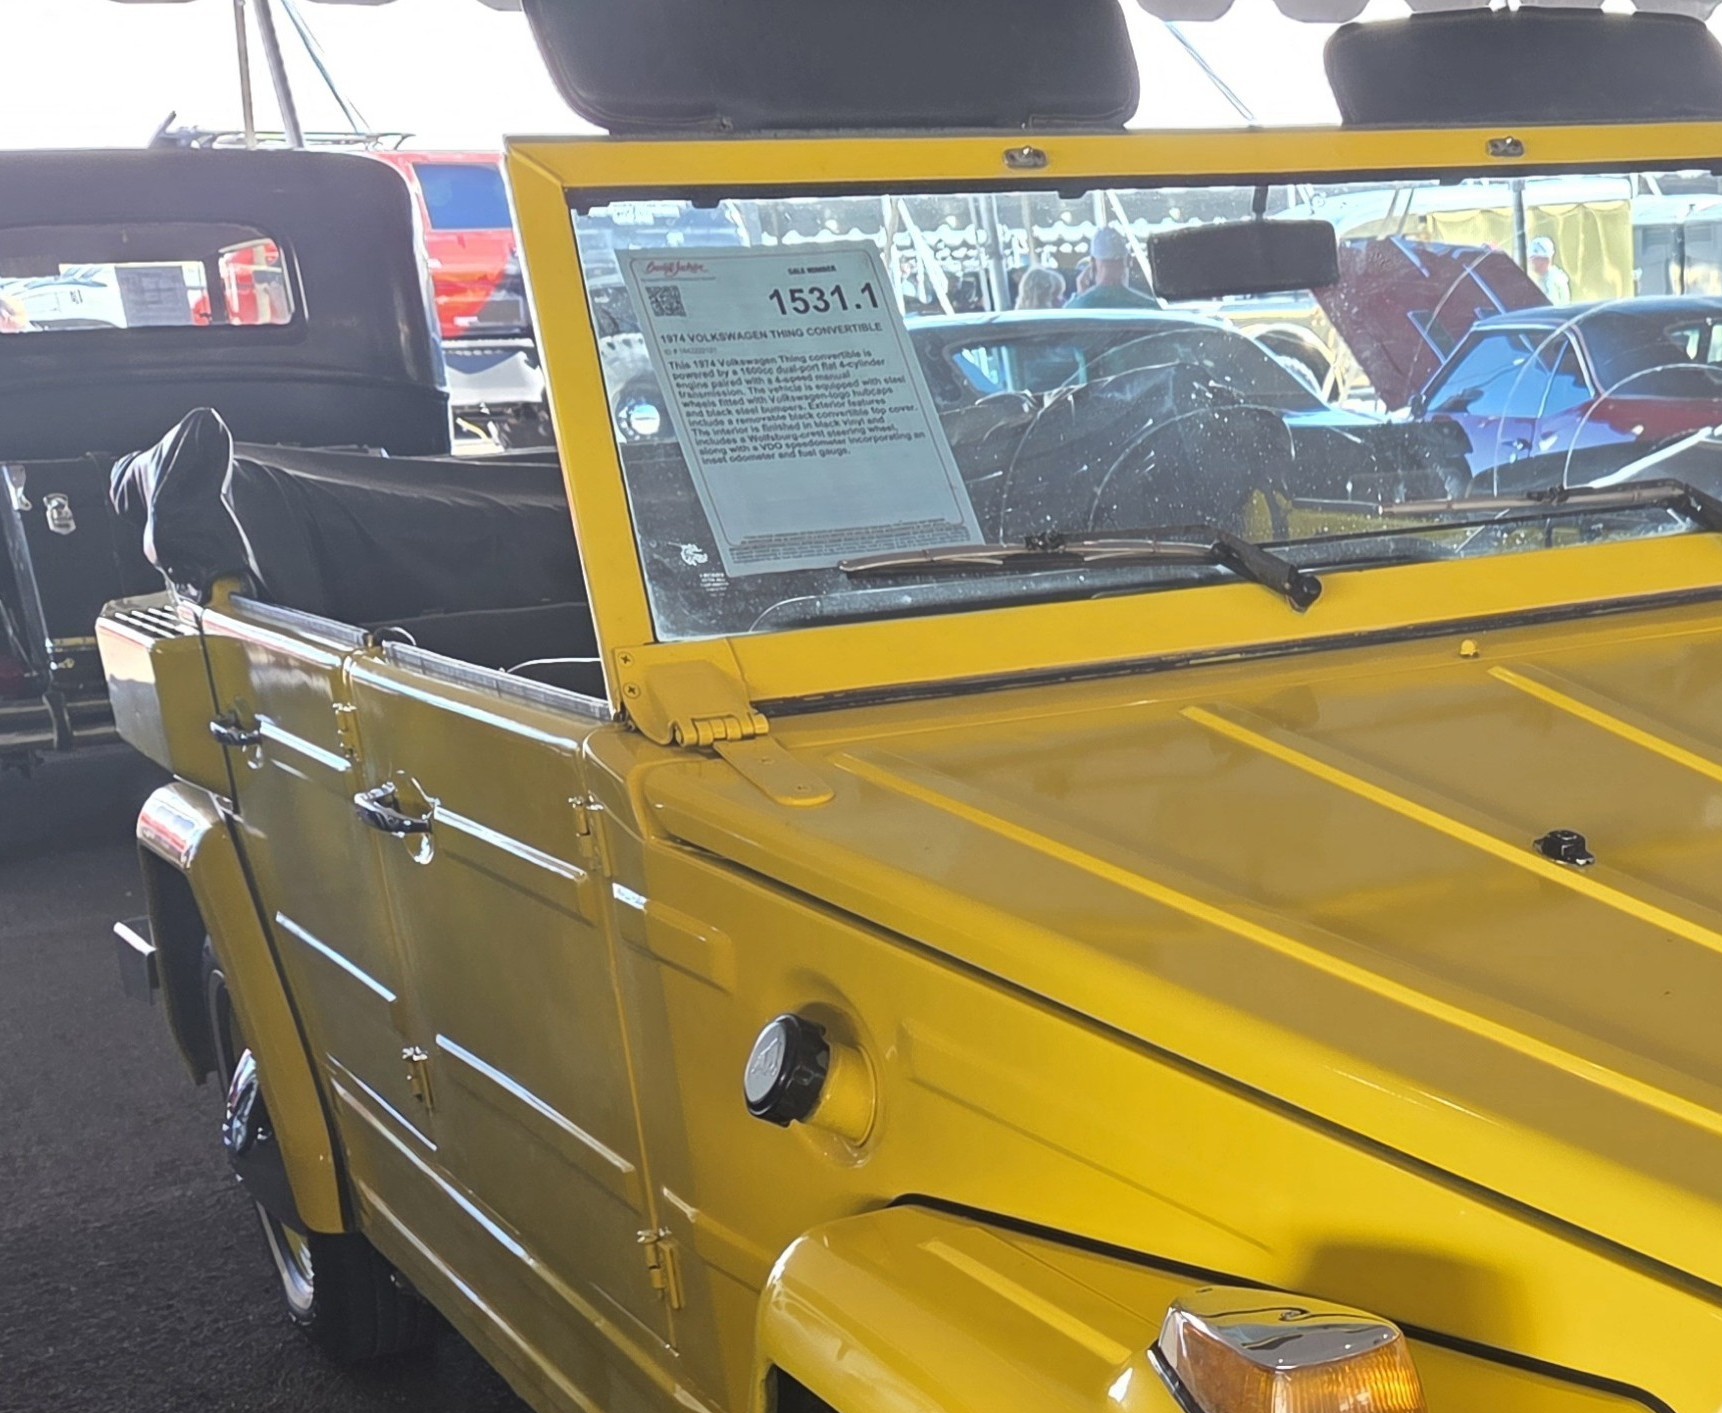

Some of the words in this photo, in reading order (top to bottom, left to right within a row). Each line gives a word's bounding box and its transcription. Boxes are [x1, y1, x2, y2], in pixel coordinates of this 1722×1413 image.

[770, 283, 877, 314] 1531.1
[661, 334, 685, 343] 1974
[687, 331, 767, 342] VOLKSWAGEN
[770, 328, 803, 338] THING
[806, 322, 881, 335] CONVERTIBLE
[668, 361, 690, 369] This
[693, 359, 715, 367] 1974
[717, 358, 776, 366] Volkswagen
[808, 350, 860, 360] convertible
[672, 369, 714, 380] powered
[716, 369, 728, 377] by
[776, 363, 819, 374] dual-port
[821, 361, 836, 370] flat
[839, 358, 884, 368] 4-cylinder
[676, 381, 708, 391] engine
[711, 377, 742, 389] paired
[744, 376, 764, 384] with
[775, 374, 812, 383] 4-speed
[815, 370, 850, 380] manual
[679, 388, 745, 398] transmission.
[747, 386, 765, 394] The
[768, 384, 801, 393] vehicle
[815, 379, 858, 390] equipped
[861, 377, 881, 385] with
[883, 375, 905, 384] steel
[682, 400, 716, 408] wheels
[718, 397, 744, 406] fitted
[746, 396, 766, 404] with
[768, 389, 850, 403] Volkswagen-logo
[852, 387, 892, 396] hubcaps
[685, 409, 703, 417] and
[705, 408, 732, 416] black
[735, 406, 758, 414] steel
[760, 404, 805, 413] bumpers.
[808, 400, 844, 409] Exterior
[847, 398, 885, 406] features
[688, 418, 724, 426] include
[736, 414, 786, 424] removable
[788, 412, 813, 420] black
[816, 408, 868, 418] convertible
[870, 406, 886, 414] top
[691, 428, 710, 436] The
[712, 426, 747, 435] interior
[761, 422, 800, 431] finished
[814, 419, 839, 427] black
[867, 416, 884, 424] and
[695, 436, 737, 445] includes
[747, 430, 824, 443] Wolfsburg-crest
[827, 427, 865, 437] steering
[867, 424, 897, 432] wheel,
[699, 447, 727, 455] along
[759, 442, 782, 450] VDO
[785, 438, 845, 450] speedometer
[848, 432, 911, 443] incorporating
[701, 455, 727, 464] inset
[729, 452, 774, 462] odometer
[778, 450, 795, 458] and
[798, 448, 816, 456] fuel
[818, 448, 850, 457] gauge.
